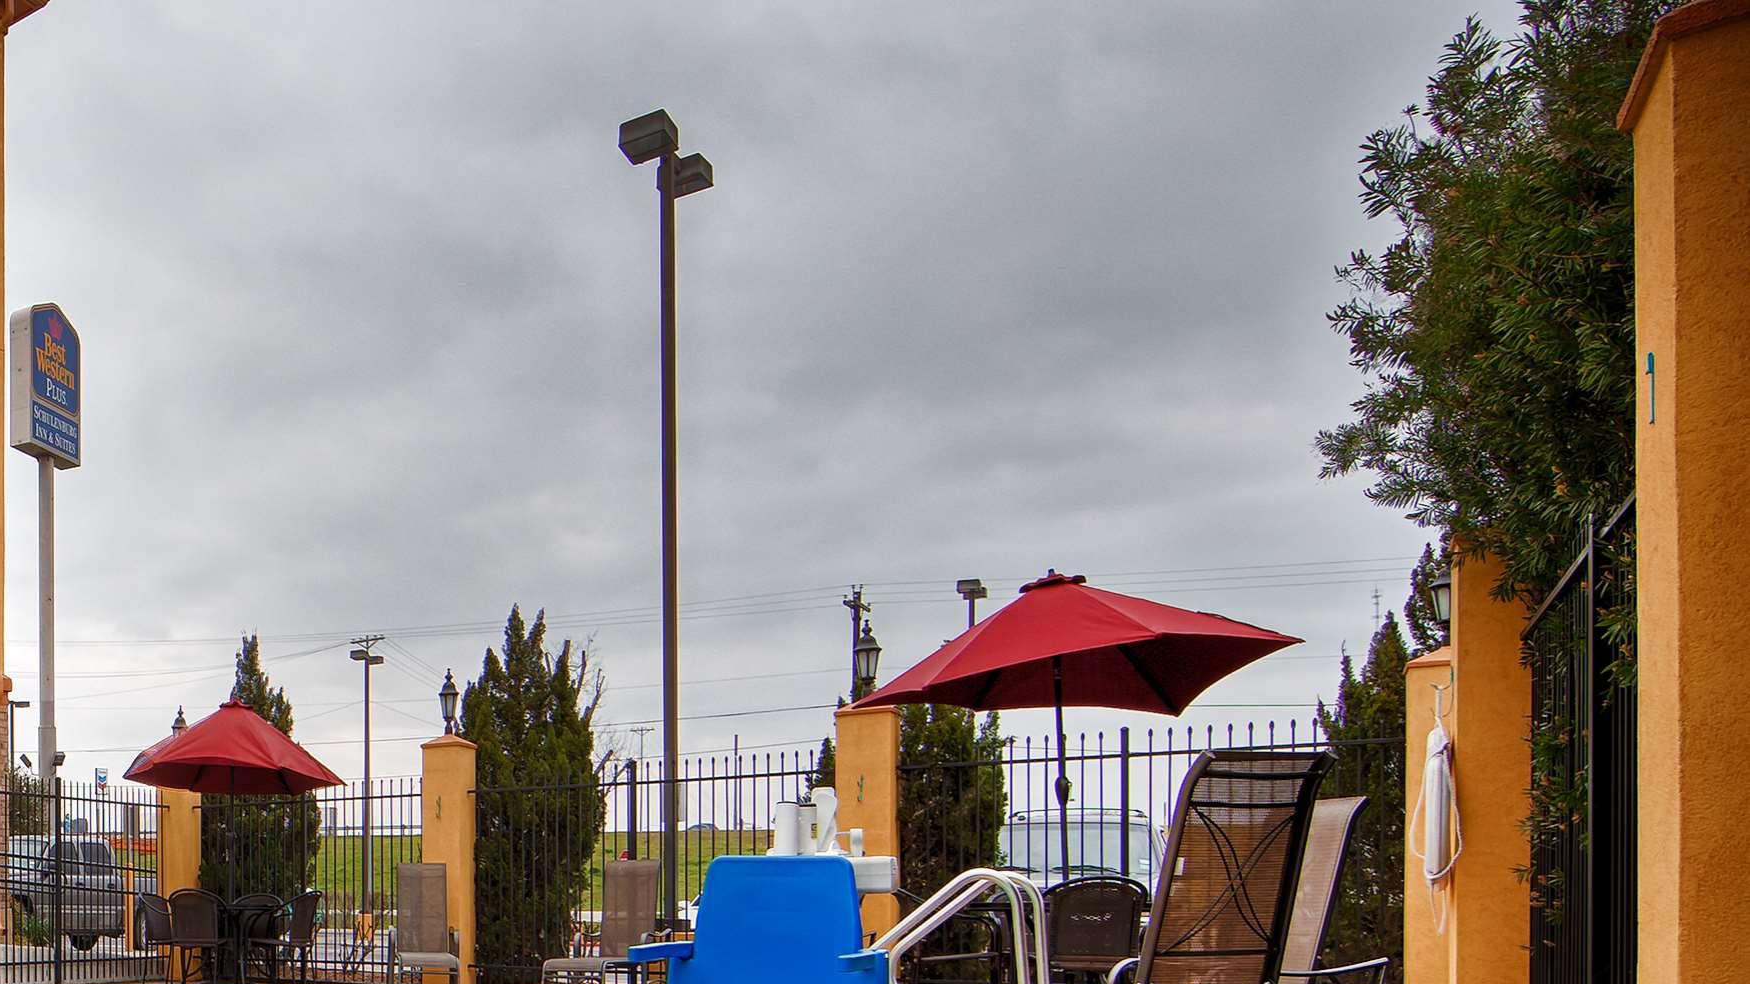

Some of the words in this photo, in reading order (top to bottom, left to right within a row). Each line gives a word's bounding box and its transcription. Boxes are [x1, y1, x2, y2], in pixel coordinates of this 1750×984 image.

[44, 333, 66, 364] Best
[35, 347, 75, 390] Western
[46, 377, 67, 405] PLUS
[35, 422, 47, 441] INN
[48, 431, 54, 444] &
[54, 433, 76, 454] SUITES
